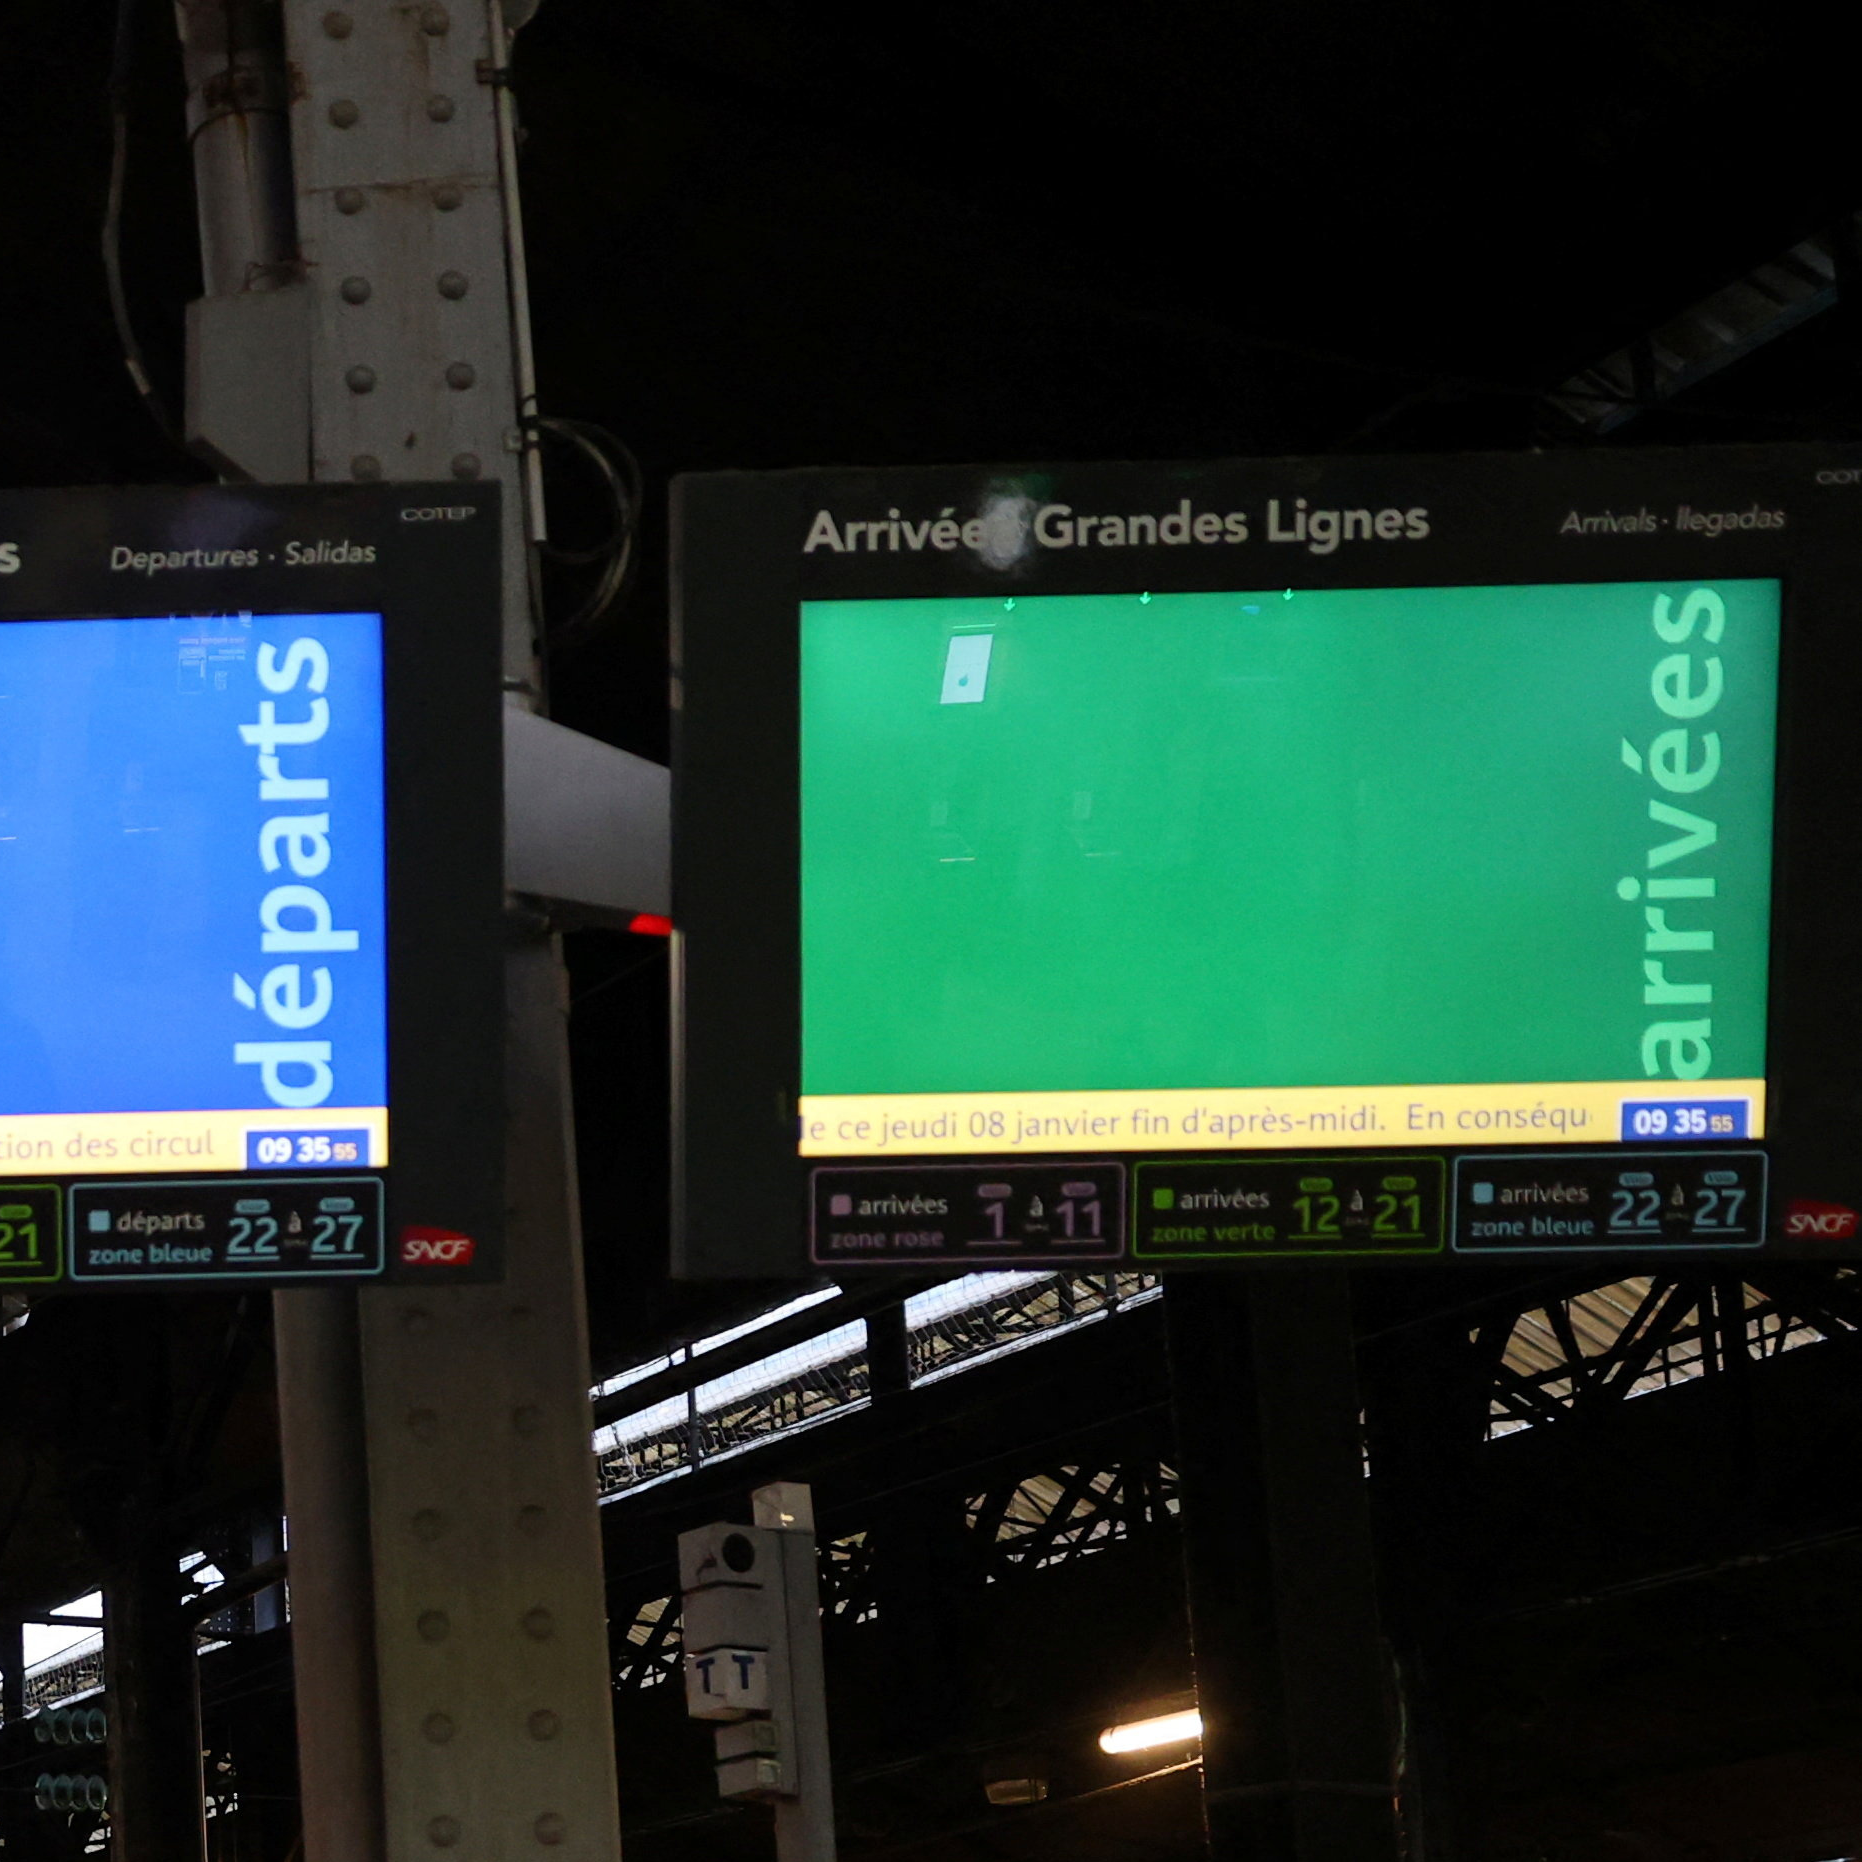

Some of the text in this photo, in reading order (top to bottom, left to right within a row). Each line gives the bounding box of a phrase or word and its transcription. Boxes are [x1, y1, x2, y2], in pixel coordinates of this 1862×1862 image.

[802, 498, 1431, 555] Arrivée Grandes Lignes
[1560, 502, 1788, 539] Arrivals llegadas
[111, 538, 377, 577] Departures Salidas
[1616, 587, 1727, 1081] arrivées
[232, 636, 360, 1108] départs
[837, 1120, 872, 1140] ce
[877, 1112, 958, 1147] jeudi
[968, 1111, 1006, 1138] 08
[1011, 1110, 1121, 1144] janvier
[1131, 1107, 1170, 1135] fin
[1181, 1104, 1386, 1140] d'après-midi.
[1407, 1103, 1445, 1131] En
[1456, 1101, 1592, 1134] conséqu
[1631, 1107, 1734, 1135] 09 35 55
[65, 1132, 119, 1158] des
[129, 1129, 214, 1157] circul
[257, 1135, 358, 1163] 09 35 55
[857, 1193, 949, 1217] arrivées
[1179, 1187, 1271, 1211] arrivées
[1499, 1180, 1591, 1204] arrivées
[983, 1201, 1005, 1239] 1
[1055, 1200, 1103, 1238] 11
[1291, 1194, 1343, 1234] 12
[1373, 1194, 1423, 1233] 21
[1609, 1188, 1663, 1228] 22
[1695, 1187, 1747, 1227] 27
[115, 1210, 206, 1236] départs
[225, 1215, 279, 1256] 22
[310, 1214, 365, 1254] 27
[1151, 1222, 1276, 1243] zone verte
[1470, 1216, 1595, 1237] zone bleue
[1786, 1212, 1856, 1234] SNCF
[402, 1238, 472, 1261] SNCF
[830, 1230, 945, 1250] zone rose
[87, 1243, 214, 1266] zone bleue
